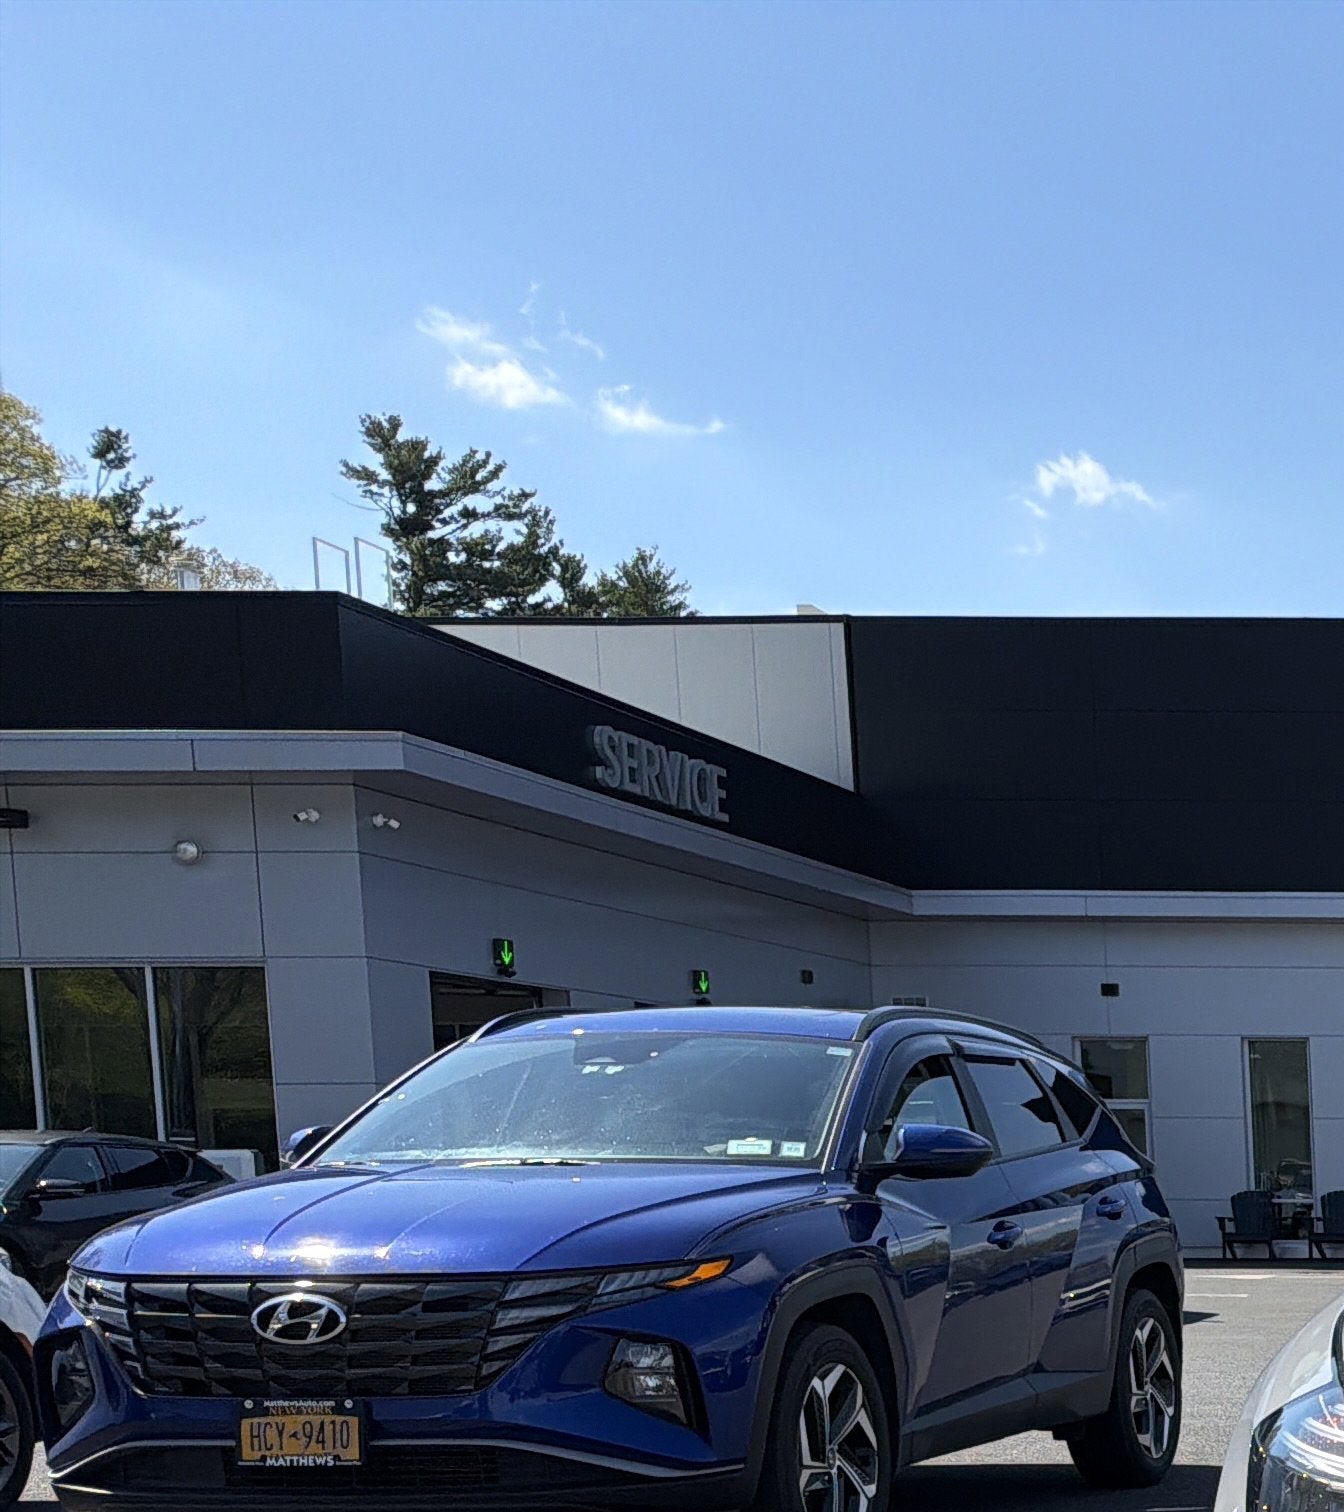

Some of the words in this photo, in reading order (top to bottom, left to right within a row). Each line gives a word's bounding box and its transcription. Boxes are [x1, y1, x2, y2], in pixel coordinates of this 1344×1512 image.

[593, 725, 729, 822] SERVICE
[268, 1406, 298, 1415] NEW
[302, 1406, 333, 1415] YORK
[265, 1455, 335, 1467] MATTHEWS
